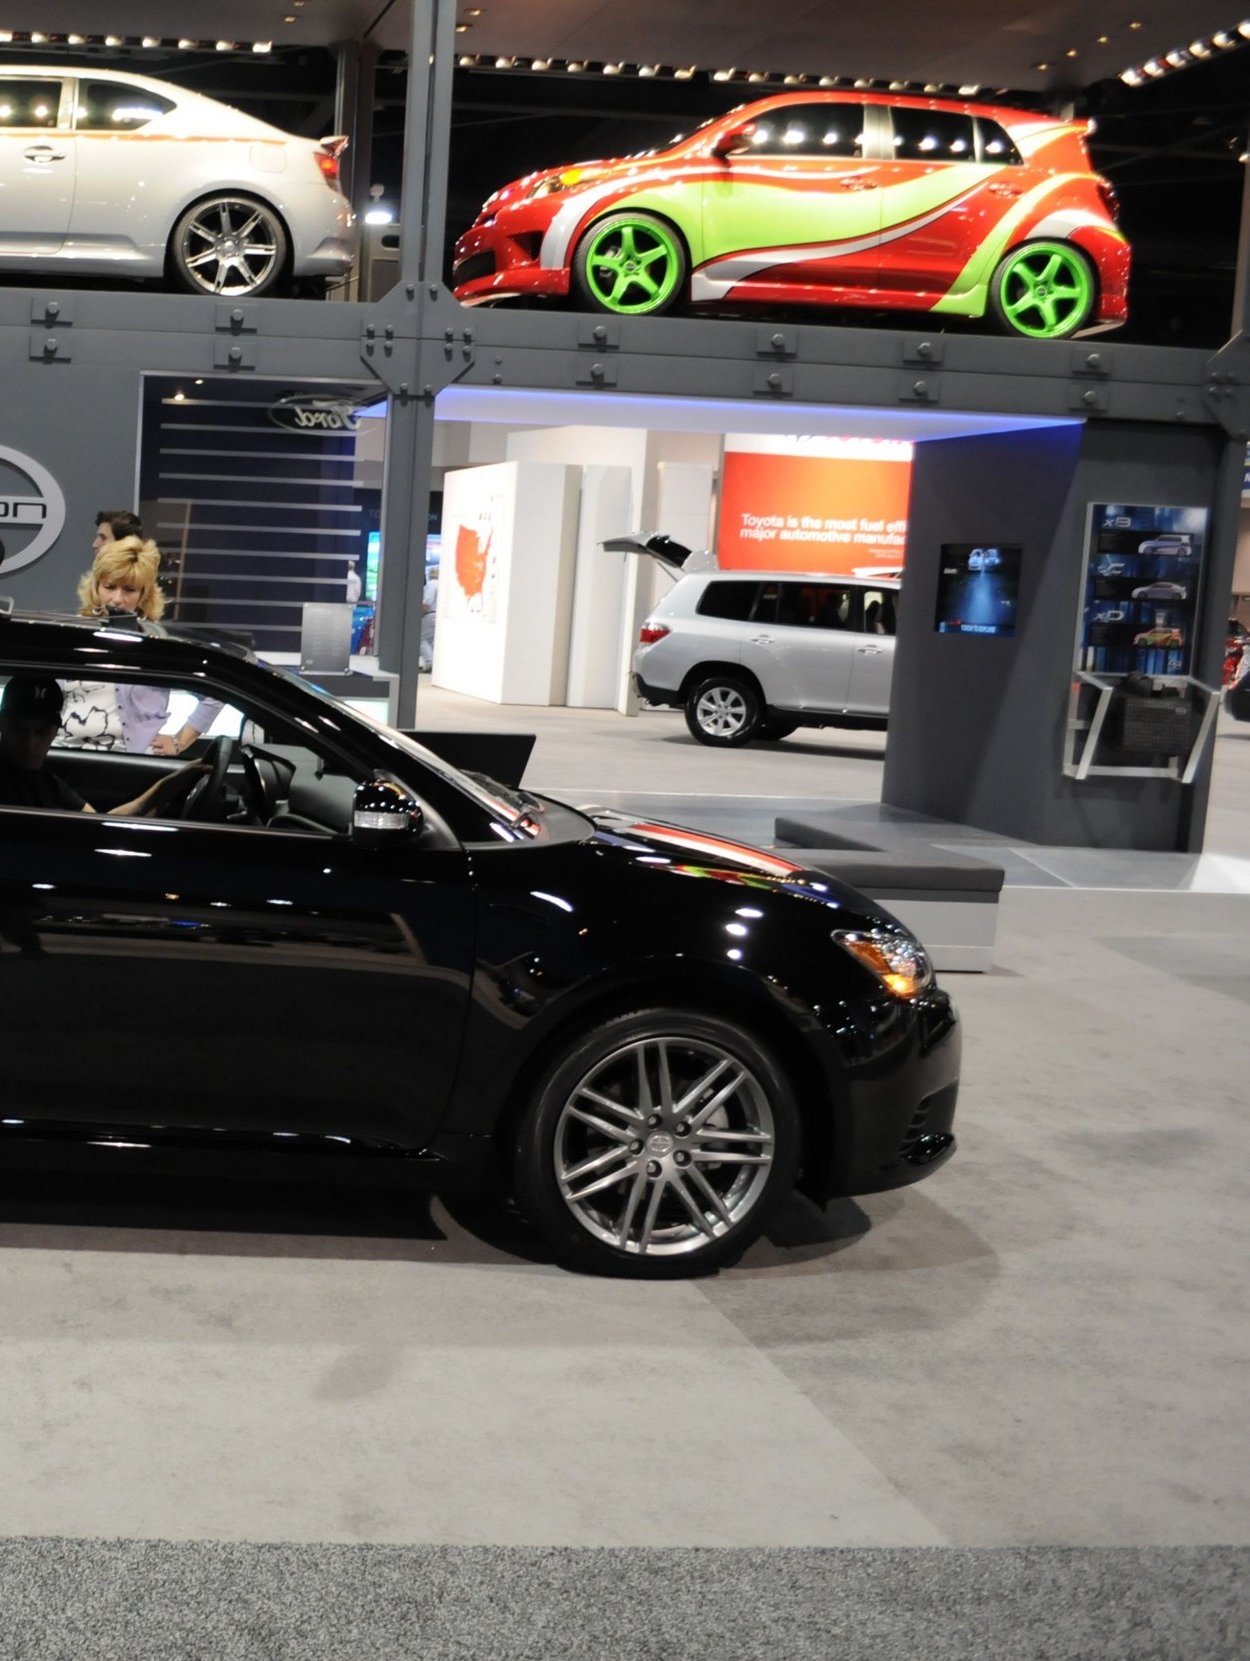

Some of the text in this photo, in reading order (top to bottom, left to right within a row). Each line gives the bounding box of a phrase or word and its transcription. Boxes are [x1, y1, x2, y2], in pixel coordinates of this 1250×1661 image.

[741, 513, 784, 529] Toyota
[787, 515, 798, 528] is
[801, 516, 822, 529] the
[825, 518, 857, 530] most
[860, 519, 883, 532] fuel
[1102, 517, 1132, 528] xB
[740, 527, 777, 541] major
[780, 529, 850, 543] automotive
[1094, 610, 1125, 622] xD
